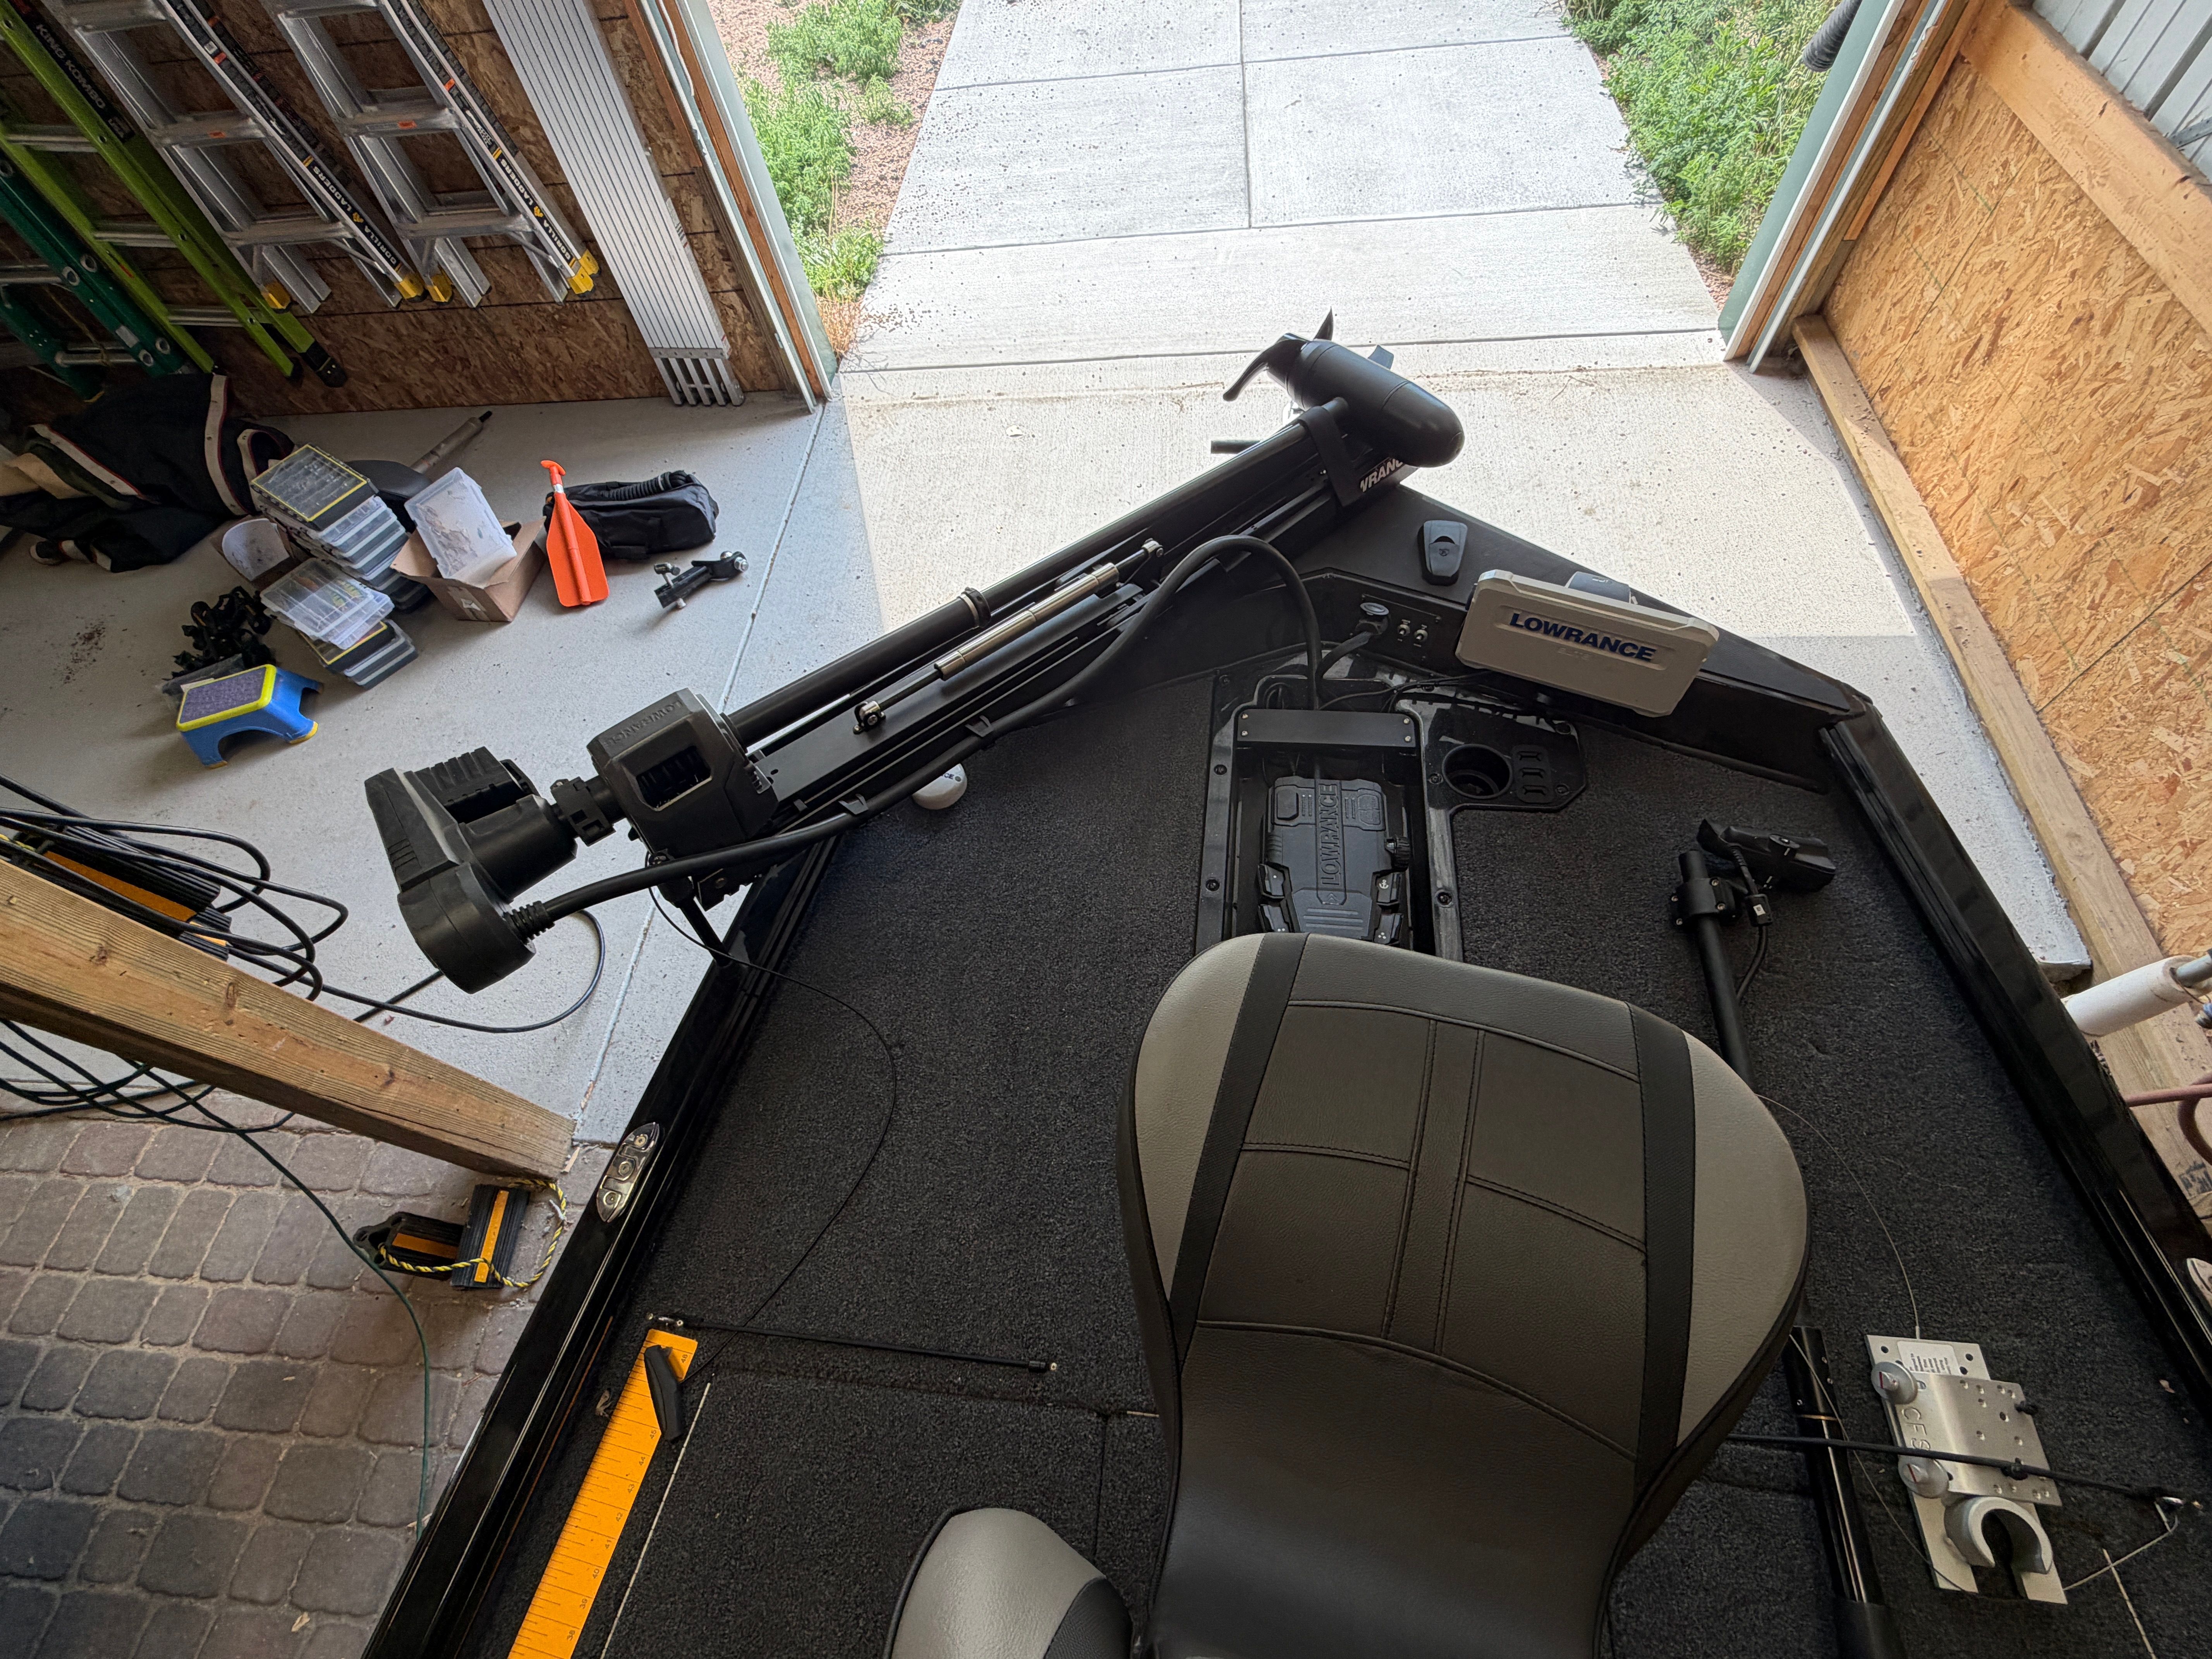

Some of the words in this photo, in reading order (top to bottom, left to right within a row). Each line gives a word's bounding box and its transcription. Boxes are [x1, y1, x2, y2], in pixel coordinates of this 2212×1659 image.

[36, 24, 66, 58] KING
[65, 60, 106, 108] KOMBO
[313, 166, 352, 211] LADDERS
[501, 159, 534, 206] LADDERS
[364, 225, 397, 265] GORILLA
[543, 219, 571, 260] GORILLA
[1510, 613, 1657, 662] LOWRANCE
[603, 700, 683, 745] LOWRANCE
[1319, 783, 1341, 886] LOWRANCE
[681, 1354, 688, 1364] 48
[649, 1429, 657, 1439] 45
[639, 1456, 646, 1466] 44
[627, 1484, 635, 1494] 43
[615, 1512, 623, 1522] 42
[605, 1539, 612, 1549] 41
[592, 1568, 600, 1580] 40
[579, 1598, 588, 1610] 39
[566, 1630, 576, 1642] 38
